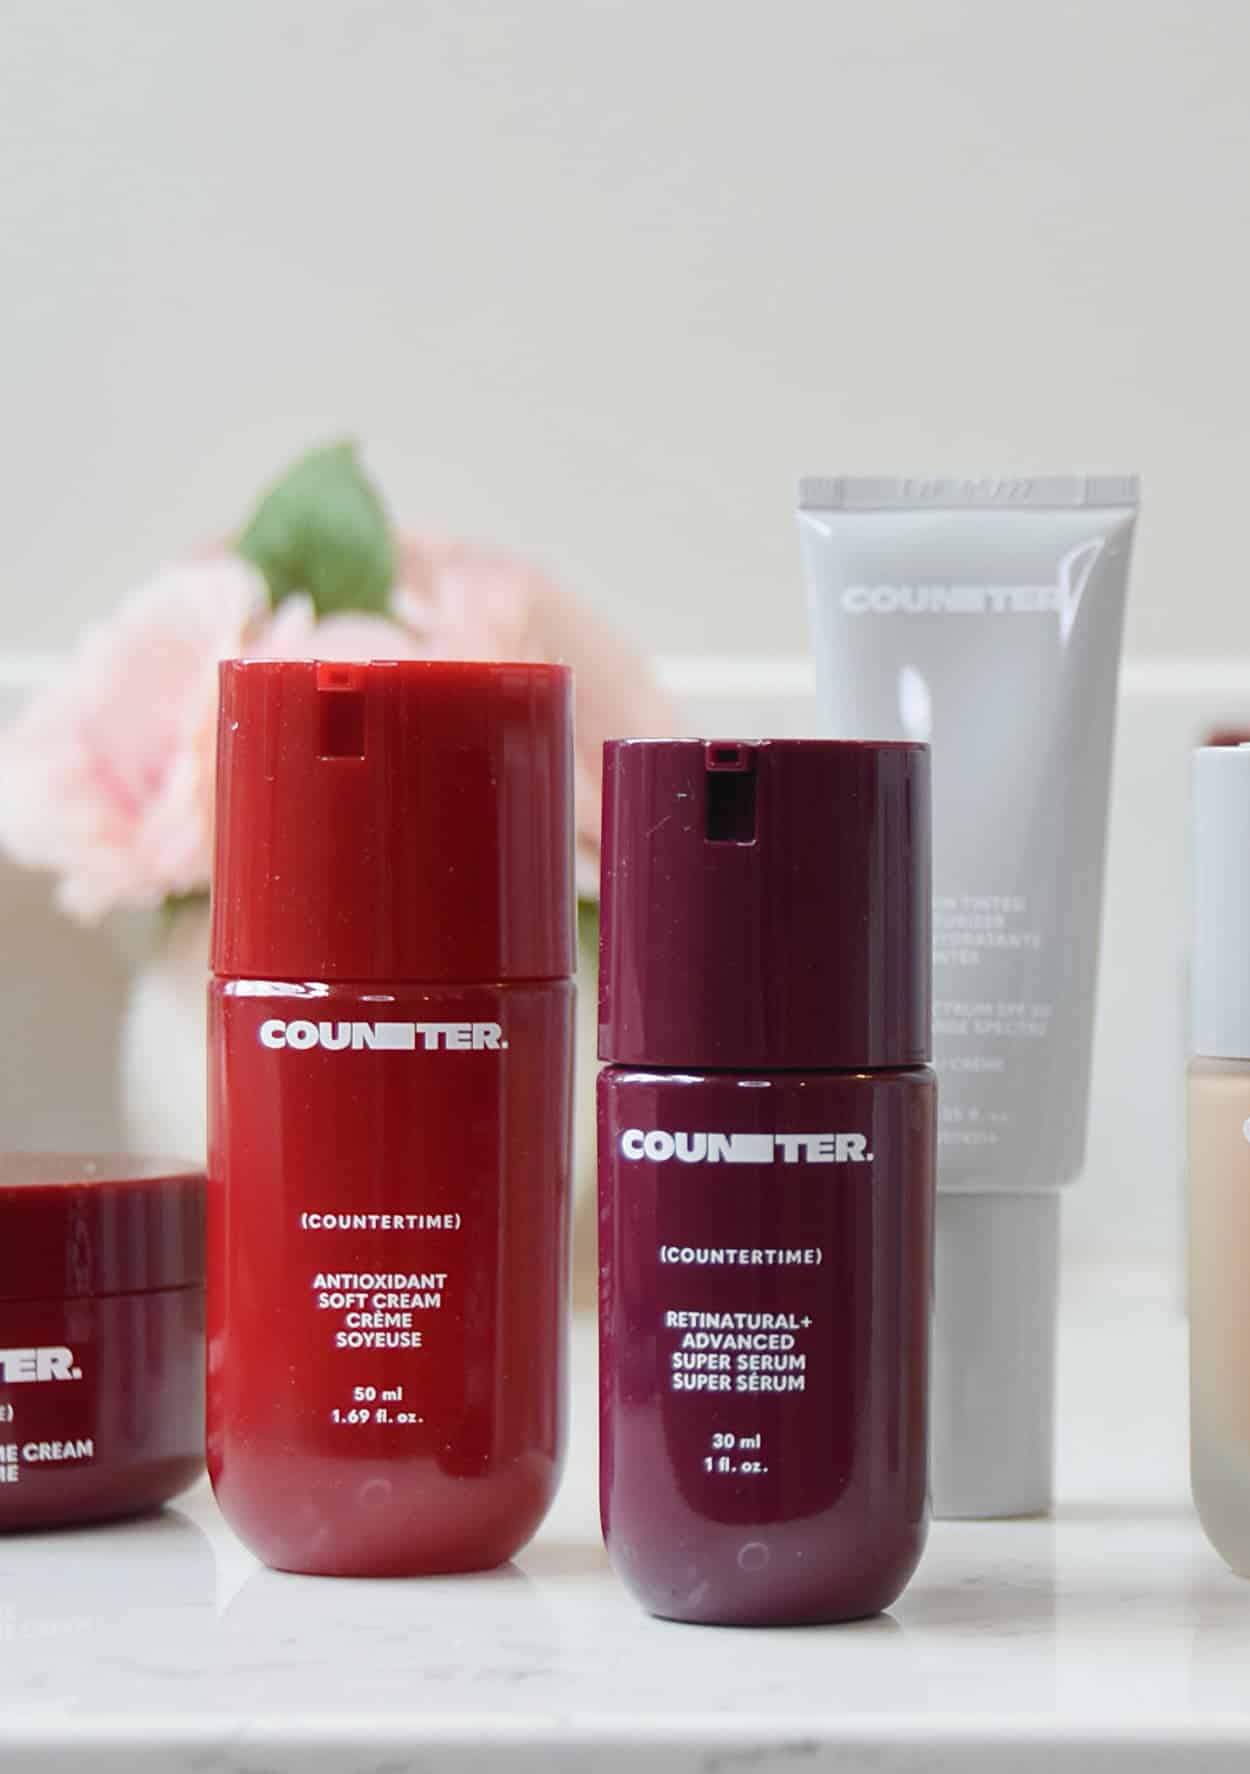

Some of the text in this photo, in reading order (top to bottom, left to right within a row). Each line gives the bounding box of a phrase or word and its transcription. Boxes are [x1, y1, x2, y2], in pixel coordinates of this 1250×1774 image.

[260, 1020, 508, 1049] COUNTER.
[621, 1129, 873, 1163] COUNTER.
[301, 1213, 462, 1232] (COUNTERTIME)
[660, 1246, 823, 1265] (COUNTERTIME)
[313, 1274, 446, 1289] ANTIOXIDANT
[319, 1293, 441, 1309] SOFT CREAM
[347, 1310, 412, 1328] CRÈME
[666, 1311, 813, 1330] RETINATURAL+
[337, 1332, 422, 1348] SOYEUSE
[683, 1333, 795, 1350] ADVANCED
[0, 1346, 82, 1382] ER.
[673, 1353, 806, 1371] SUPER SERUM
[673, 1371, 805, 1392] SUPER SÉRUM
[354, 1387, 402, 1401] 50 ml
[331, 1409, 424, 1424] 1.69 fl. oz.
[713, 1434, 760, 1448] 30 ml
[0, 1440, 93, 1463] E CREAM
[0, 1464, 19, 1482] E
[704, 1457, 768, 1473] 1 fl. oz.
